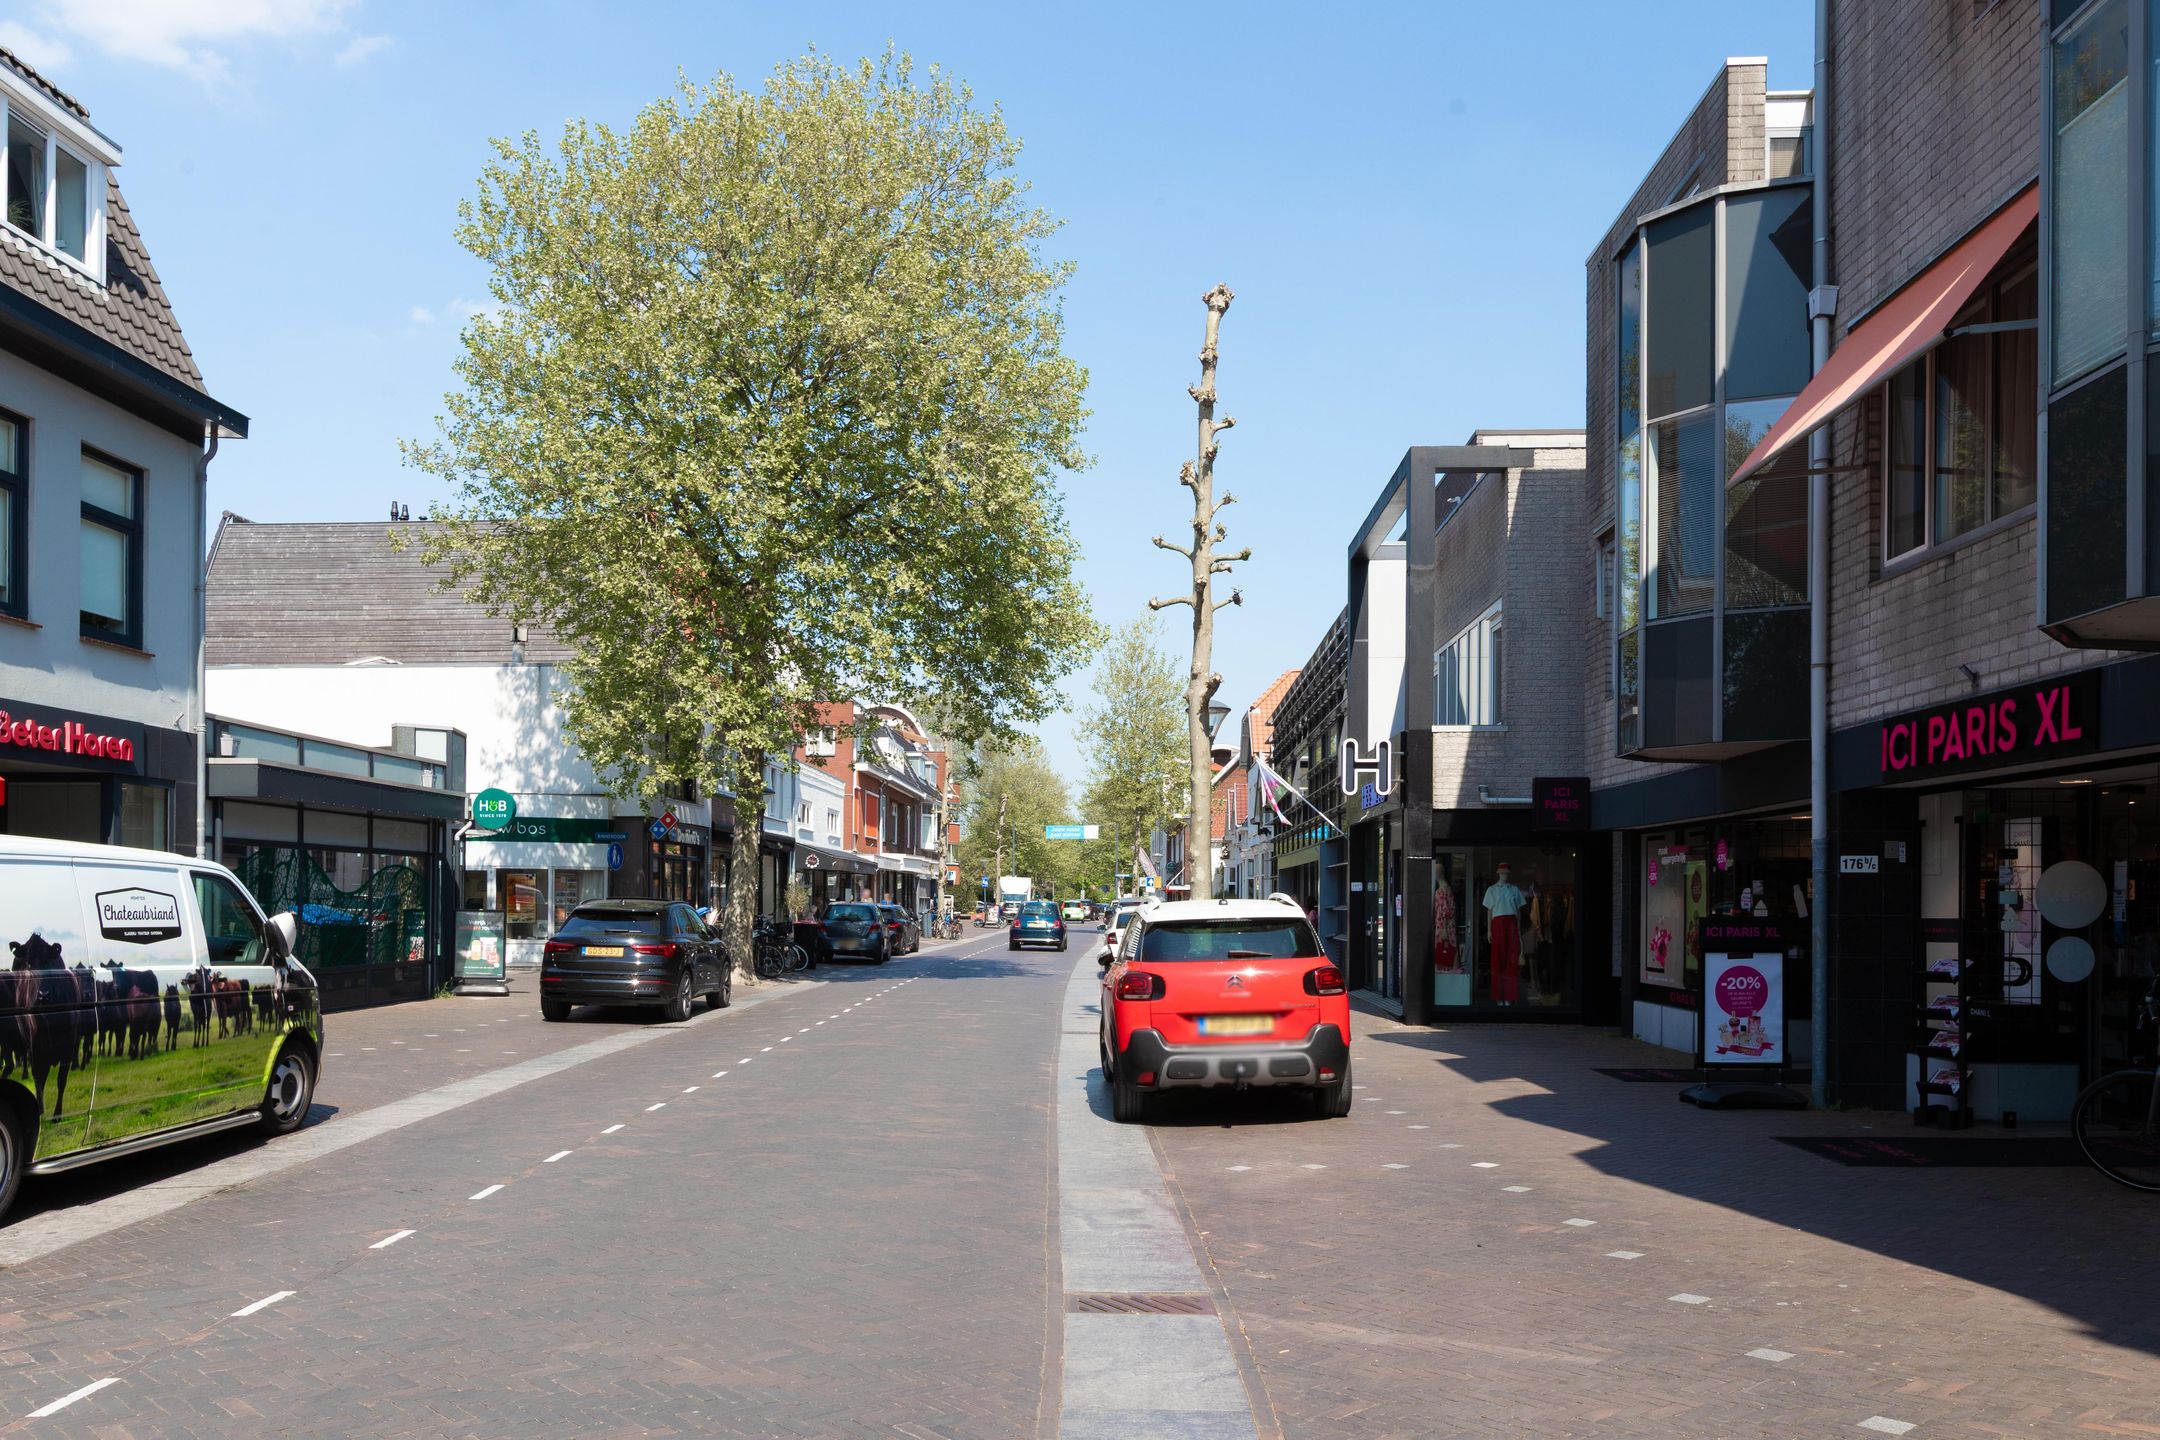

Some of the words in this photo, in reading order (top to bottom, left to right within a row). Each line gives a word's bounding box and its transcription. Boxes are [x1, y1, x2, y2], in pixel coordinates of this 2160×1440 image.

[1881, 720, 1918, 773] ICI
[1927, 698, 2018, 765] PARIS
[2033, 685, 2084, 747] XL
[64, 721, 134, 761] Horen
[1551, 787, 1572, 797] ICI
[479, 800, 507, 811] H&B
[1543, 799, 1580, 809] PARIS
[1553, 811, 1569, 822] XL
[677, 828, 700, 845] Domino's
[104, 904, 175, 920] Chateaubriand
[1706, 926, 1723, 937] ICI
[1726, 926, 1760, 937] PARIS
[1765, 926, 1781, 937] XL
[1721, 976, 1761, 990] -20%
